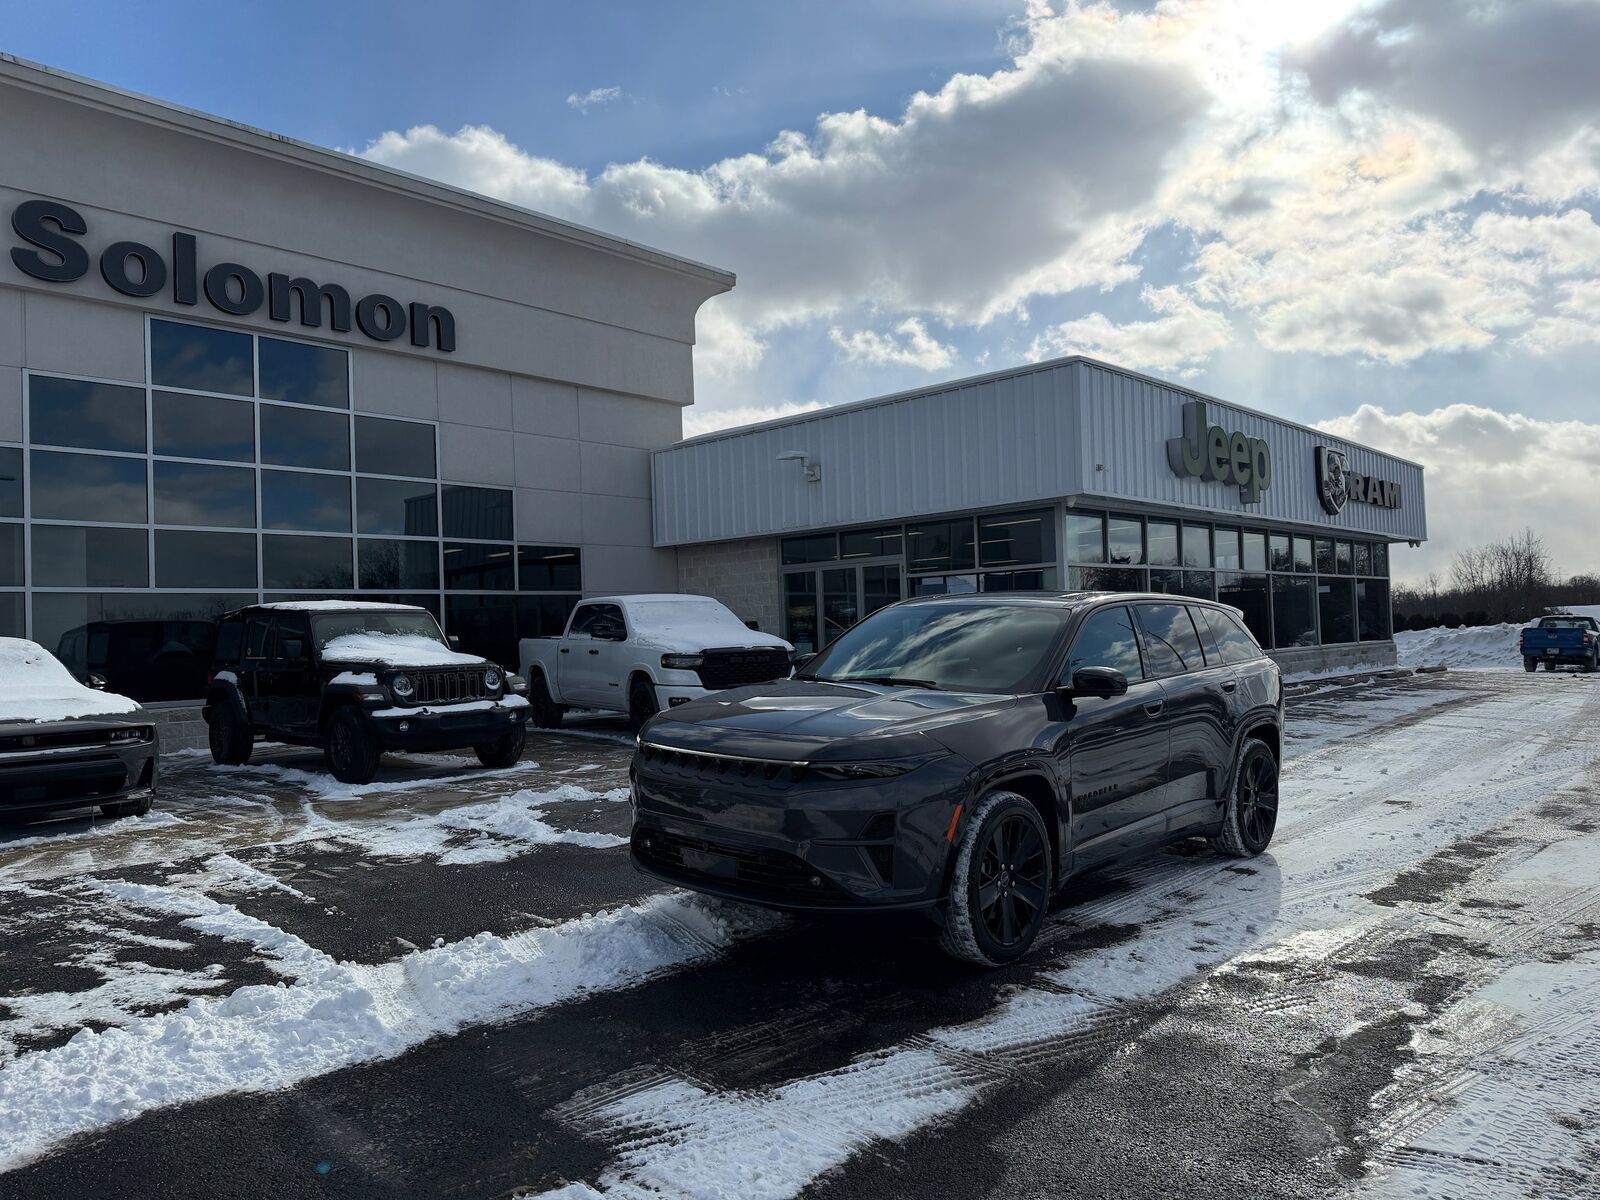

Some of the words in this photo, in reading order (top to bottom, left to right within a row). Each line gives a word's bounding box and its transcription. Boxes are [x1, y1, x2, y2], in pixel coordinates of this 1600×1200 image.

[10, 200, 456, 352] Solomon
[1169, 402, 1271, 503] Jeep
[1350, 471, 1401, 509] RAM
